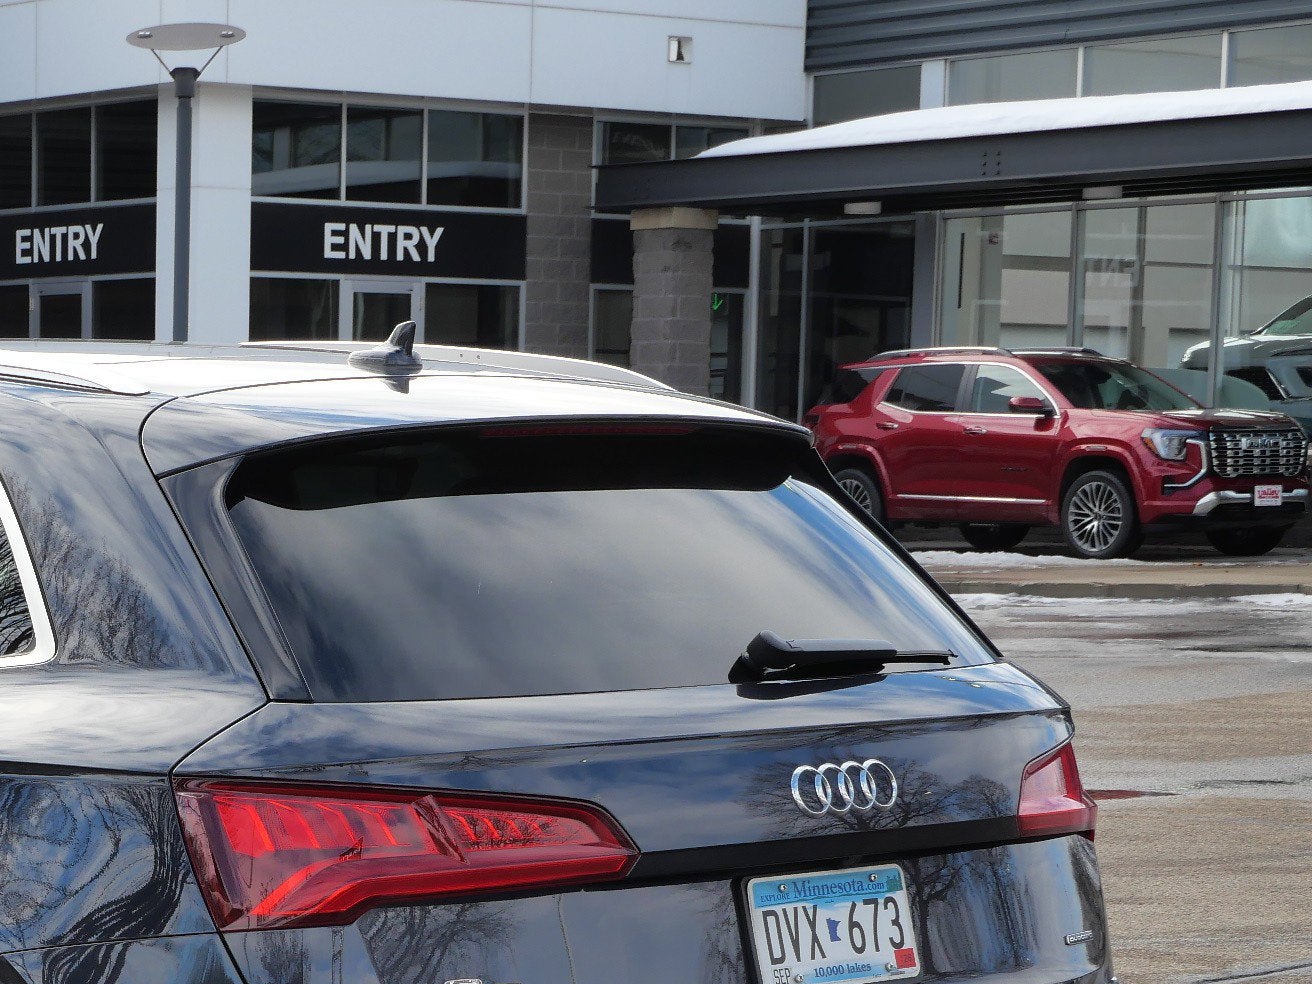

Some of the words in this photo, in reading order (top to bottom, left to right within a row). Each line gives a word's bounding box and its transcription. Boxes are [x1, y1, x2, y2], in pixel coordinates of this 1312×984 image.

[15, 223, 104, 265] ENTRY
[324, 223, 444, 262] ENTRY
[792, 878, 885, 898] Minnesota.com
[762, 905, 826, 965] DVX
[848, 896, 905, 955] 673
[814, 965, 845, 978] 10,000
[847, 963, 872, 974] lakes
